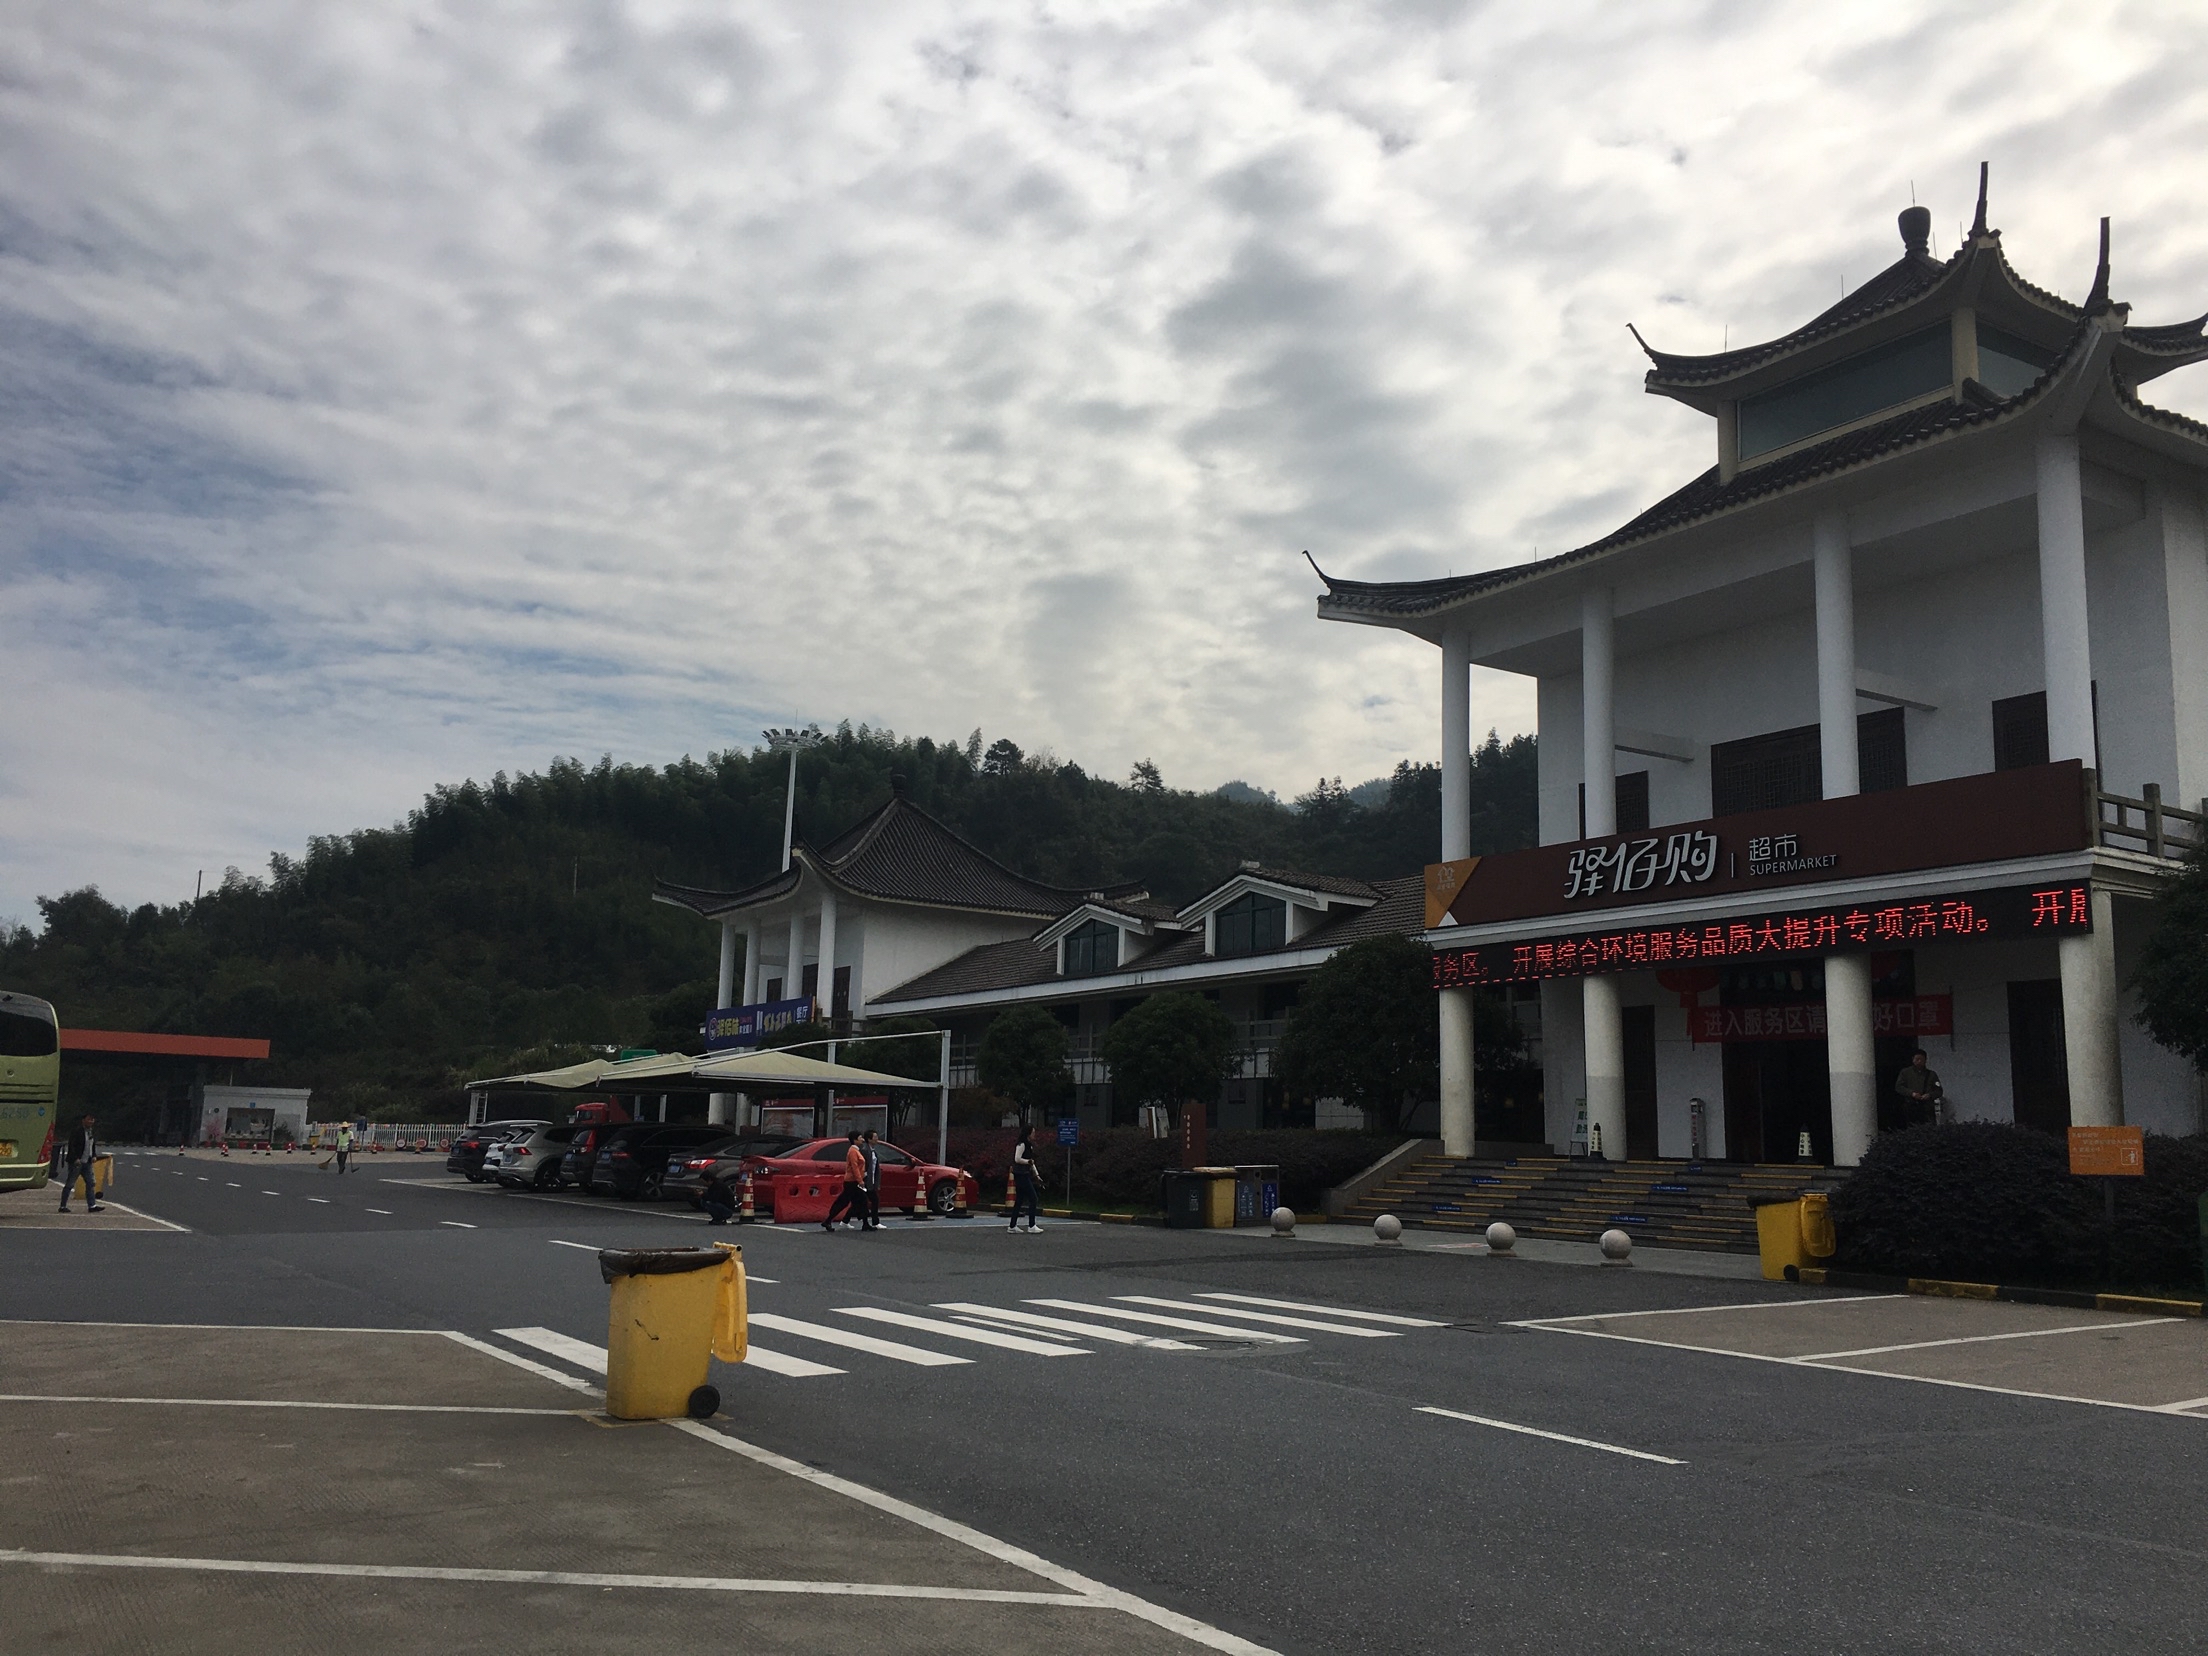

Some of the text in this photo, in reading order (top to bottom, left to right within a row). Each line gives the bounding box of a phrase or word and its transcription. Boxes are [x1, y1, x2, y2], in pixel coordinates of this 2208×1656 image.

[1748, 833, 1797, 861] 超市
[1749, 854, 1837, 876] SUPERMARKET
[1703, 1001, 1940, 1037] 进入服务区请好口罩
